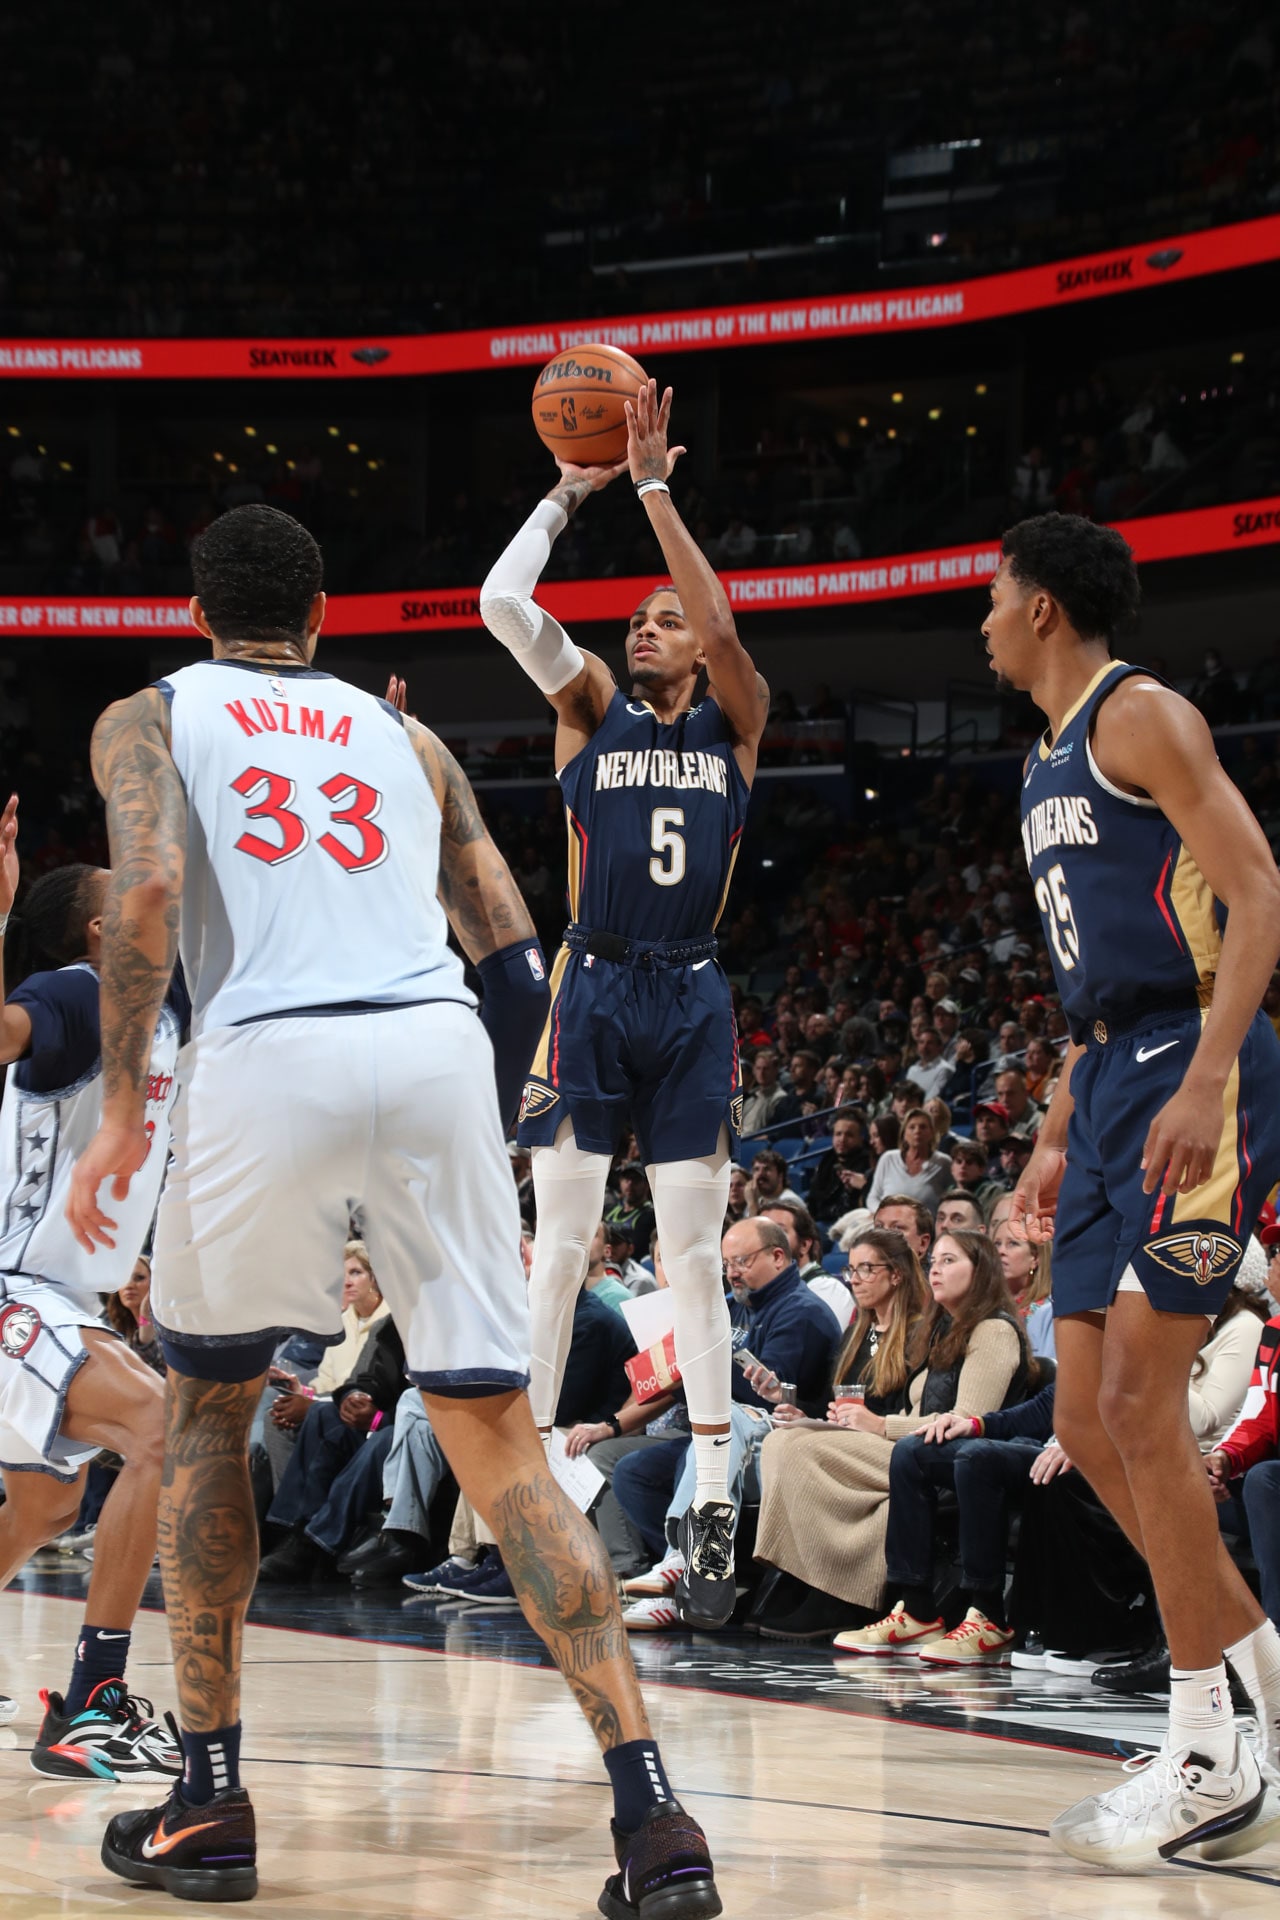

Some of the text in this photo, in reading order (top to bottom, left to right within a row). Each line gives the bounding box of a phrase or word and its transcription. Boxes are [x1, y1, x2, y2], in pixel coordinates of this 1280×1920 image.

[490, 292, 964, 359] OFFICIAL TICKETING PARTNER OF THE NEW ORLEANS PELICANS
[61, 347, 143, 369] PELICANS
[249, 347, 337, 369] SEATGEEK
[540, 359, 613, 386] Wilson
[729, 574, 815, 601] TICKETING
[818, 567, 888, 595] PARTNER
[890, 562, 909, 588] OF
[911, 557, 938, 584] THE
[939, 555, 972, 580] NEW
[20, 605, 42, 627] OF
[46, 605, 78, 626] THE
[80, 606, 120, 626] NEW
[224, 697, 352, 747] KUZMA
[595, 749, 727, 798] NEW ORLEANS
[228, 765, 390, 874] 33
[1031, 796, 1099, 856] ORLEANS
[649, 807, 686, 886] 5
[1034, 863, 1080, 972] 25
